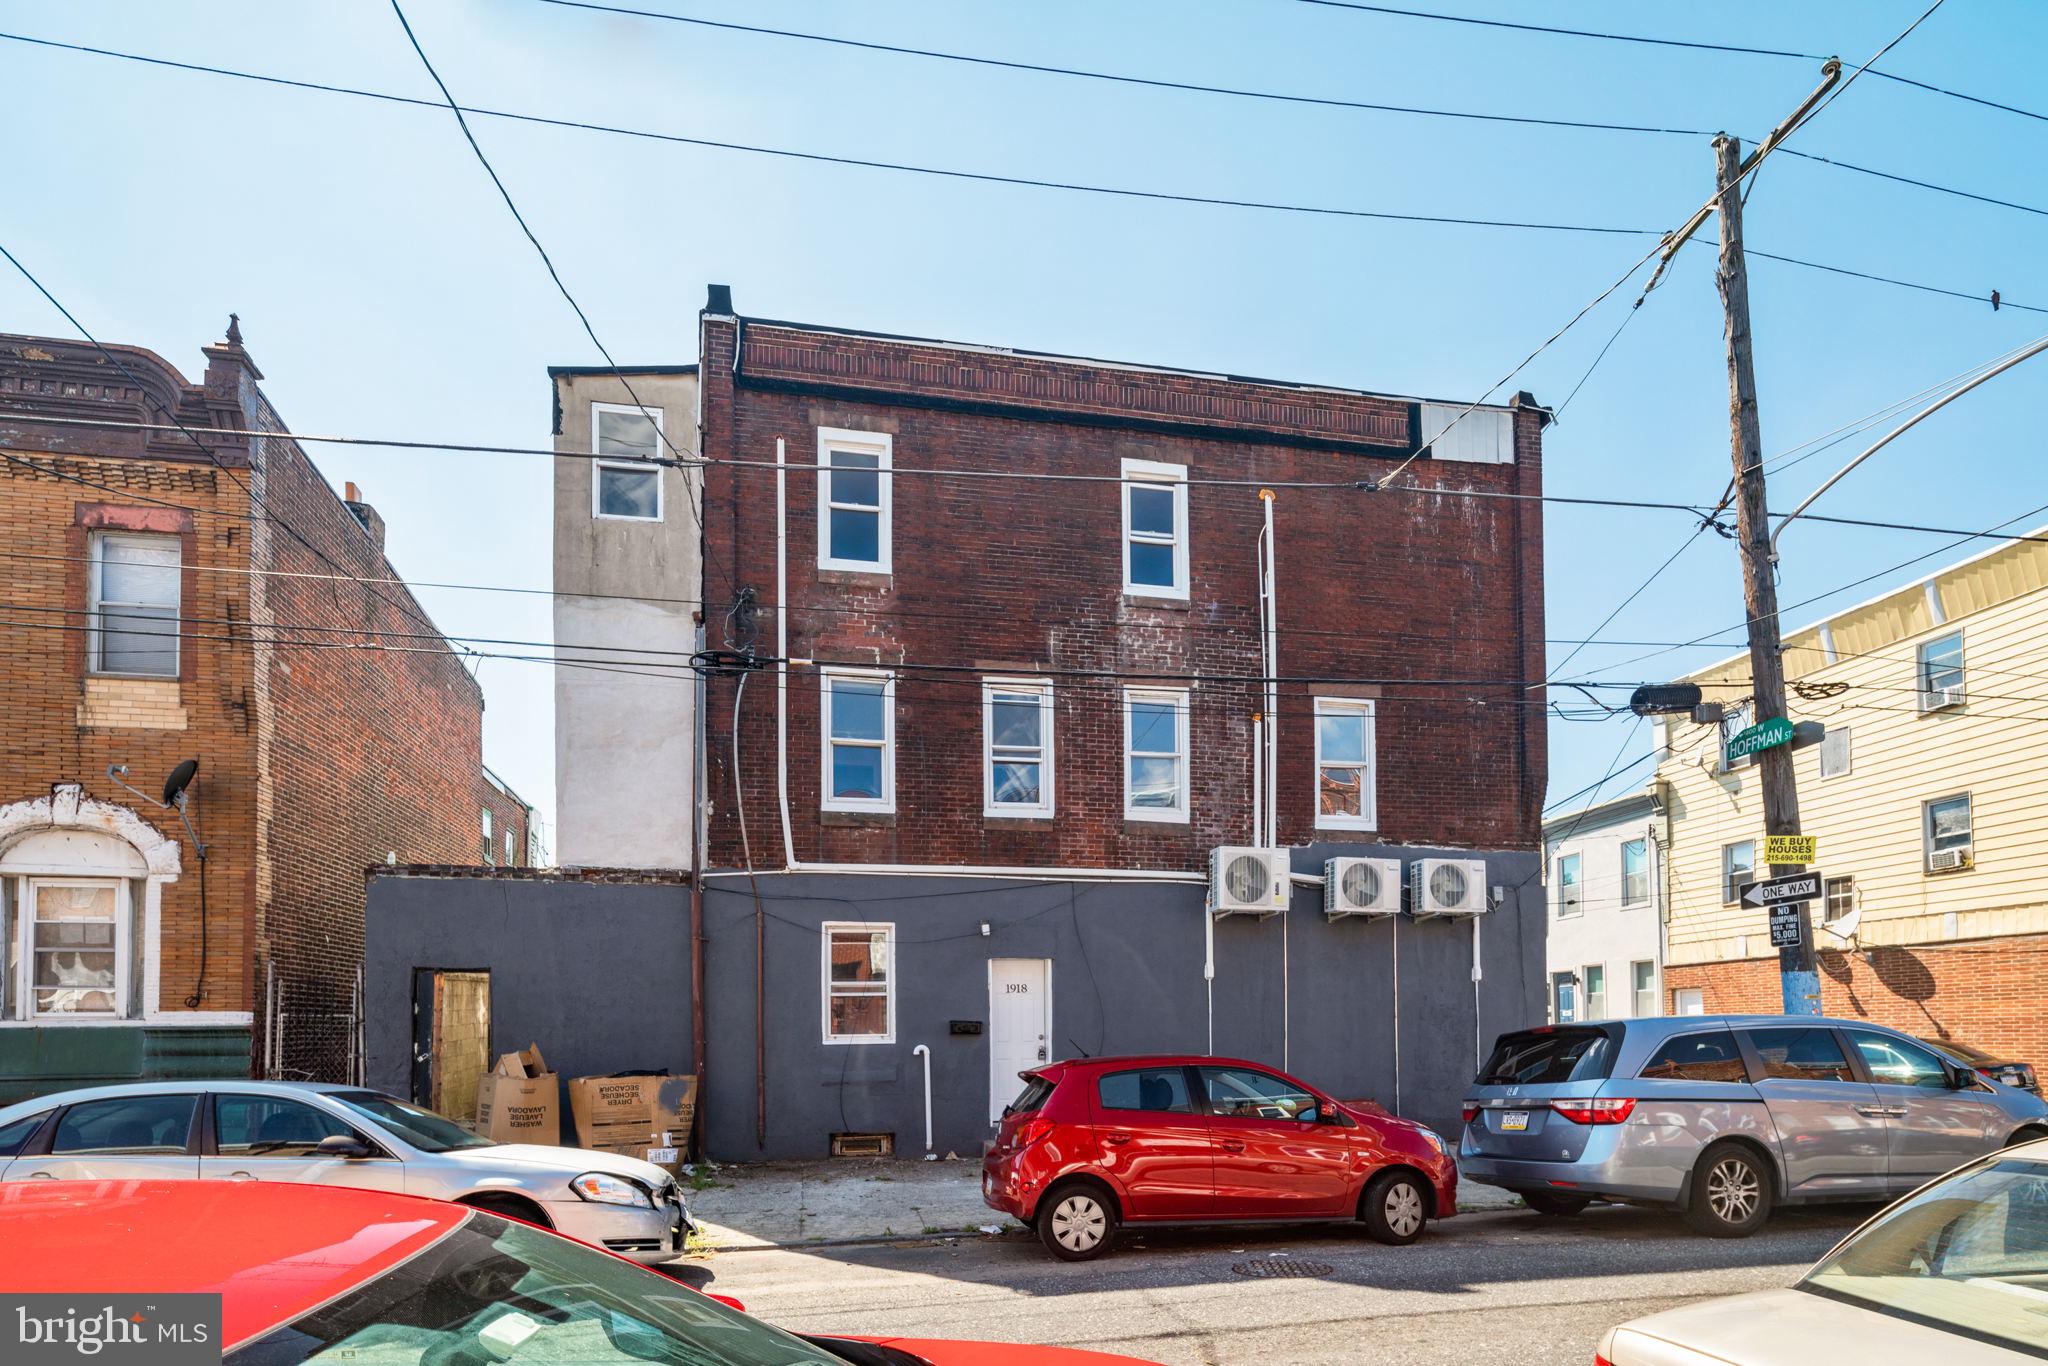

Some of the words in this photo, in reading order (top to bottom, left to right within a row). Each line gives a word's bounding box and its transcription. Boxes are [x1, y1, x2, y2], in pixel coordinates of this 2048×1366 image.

[1757, 723, 1765, 732] W
[1729, 726, 1783, 758] HOFFMAN
[1784, 730, 1792, 740] ST
[1770, 837, 1786, 846] WE
[1789, 837, 1812, 846] BUY
[1768, 845, 1812, 854] HOUSES
[1766, 854, 1812, 862] 215-690-1498
[1762, 886, 1785, 899] ONE
[1788, 881, 1812, 895] WAY
[1777, 906, 1790, 915] NO
[1770, 914, 1798, 925] DUMPING
[1773, 929, 1797, 940] $5,000
[1005, 983, 1028, 994] 1918
[599, 1084, 640, 1093] SECADORA
[600, 1091, 640, 1099] SECHEUSE
[607, 1098, 633, 1106] DRYER
